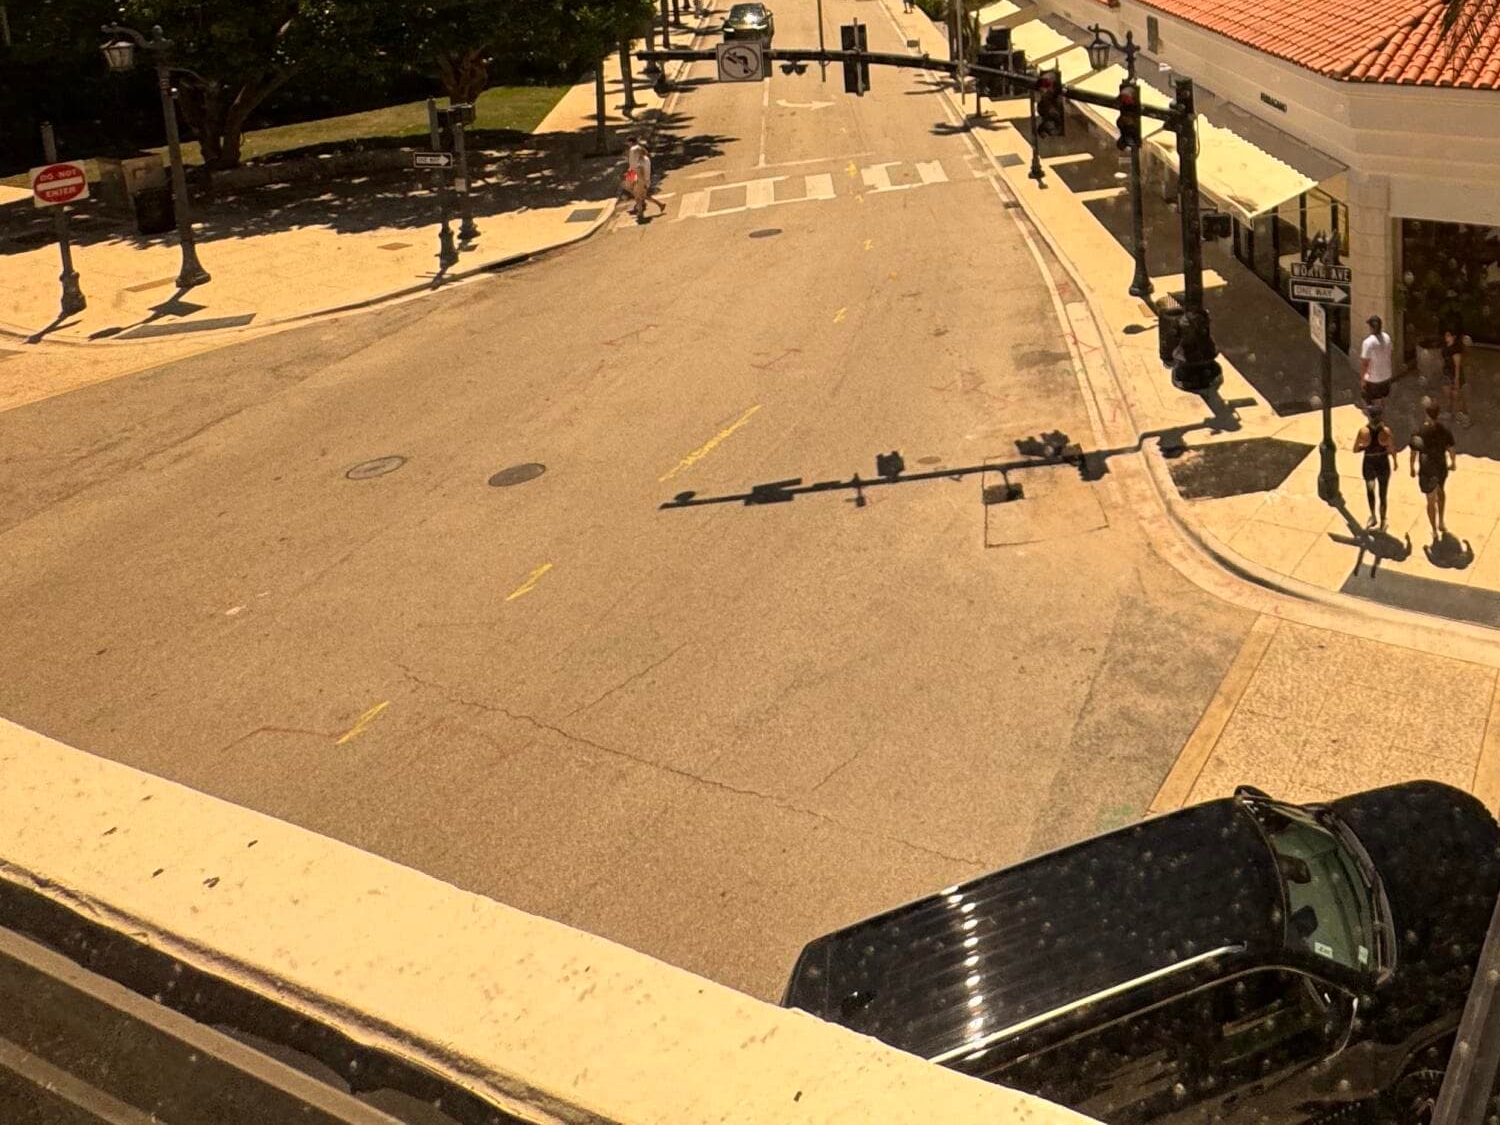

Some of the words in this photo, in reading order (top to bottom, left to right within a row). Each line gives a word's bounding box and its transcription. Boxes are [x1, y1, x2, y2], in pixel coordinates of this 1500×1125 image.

[40, 173, 54, 181] DO
[58, 169, 77, 177] NOT
[46, 186, 77, 198] ENTER
[1330, 267, 1349, 281] AVE
[1295, 285, 1312, 295] ONE
[1315, 287, 1332, 297] WAY
